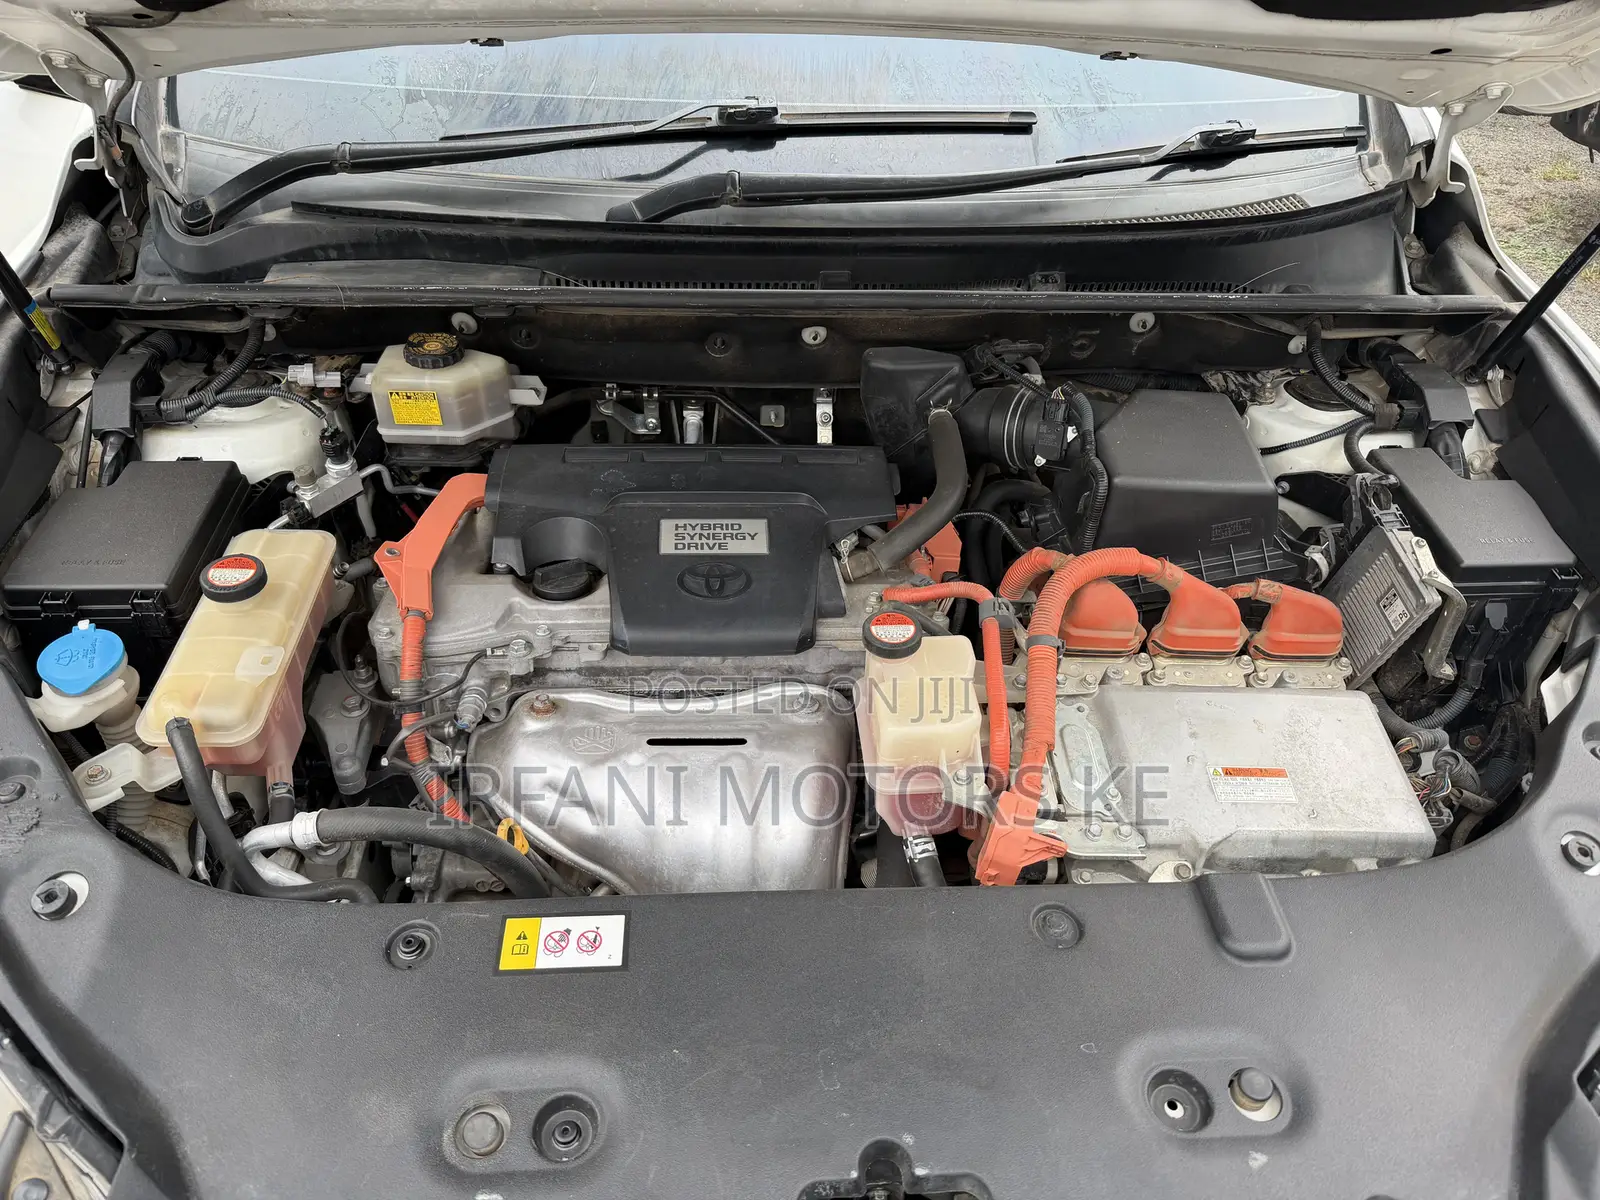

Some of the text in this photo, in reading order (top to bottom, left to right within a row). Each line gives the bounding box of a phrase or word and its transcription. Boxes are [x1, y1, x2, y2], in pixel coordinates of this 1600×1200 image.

[674, 523, 742, 531] HYBRID
[674, 532, 759, 541] SYNERGY
[674, 542, 729, 551] DRIVE
[1397, 609, 1409, 623] P6
